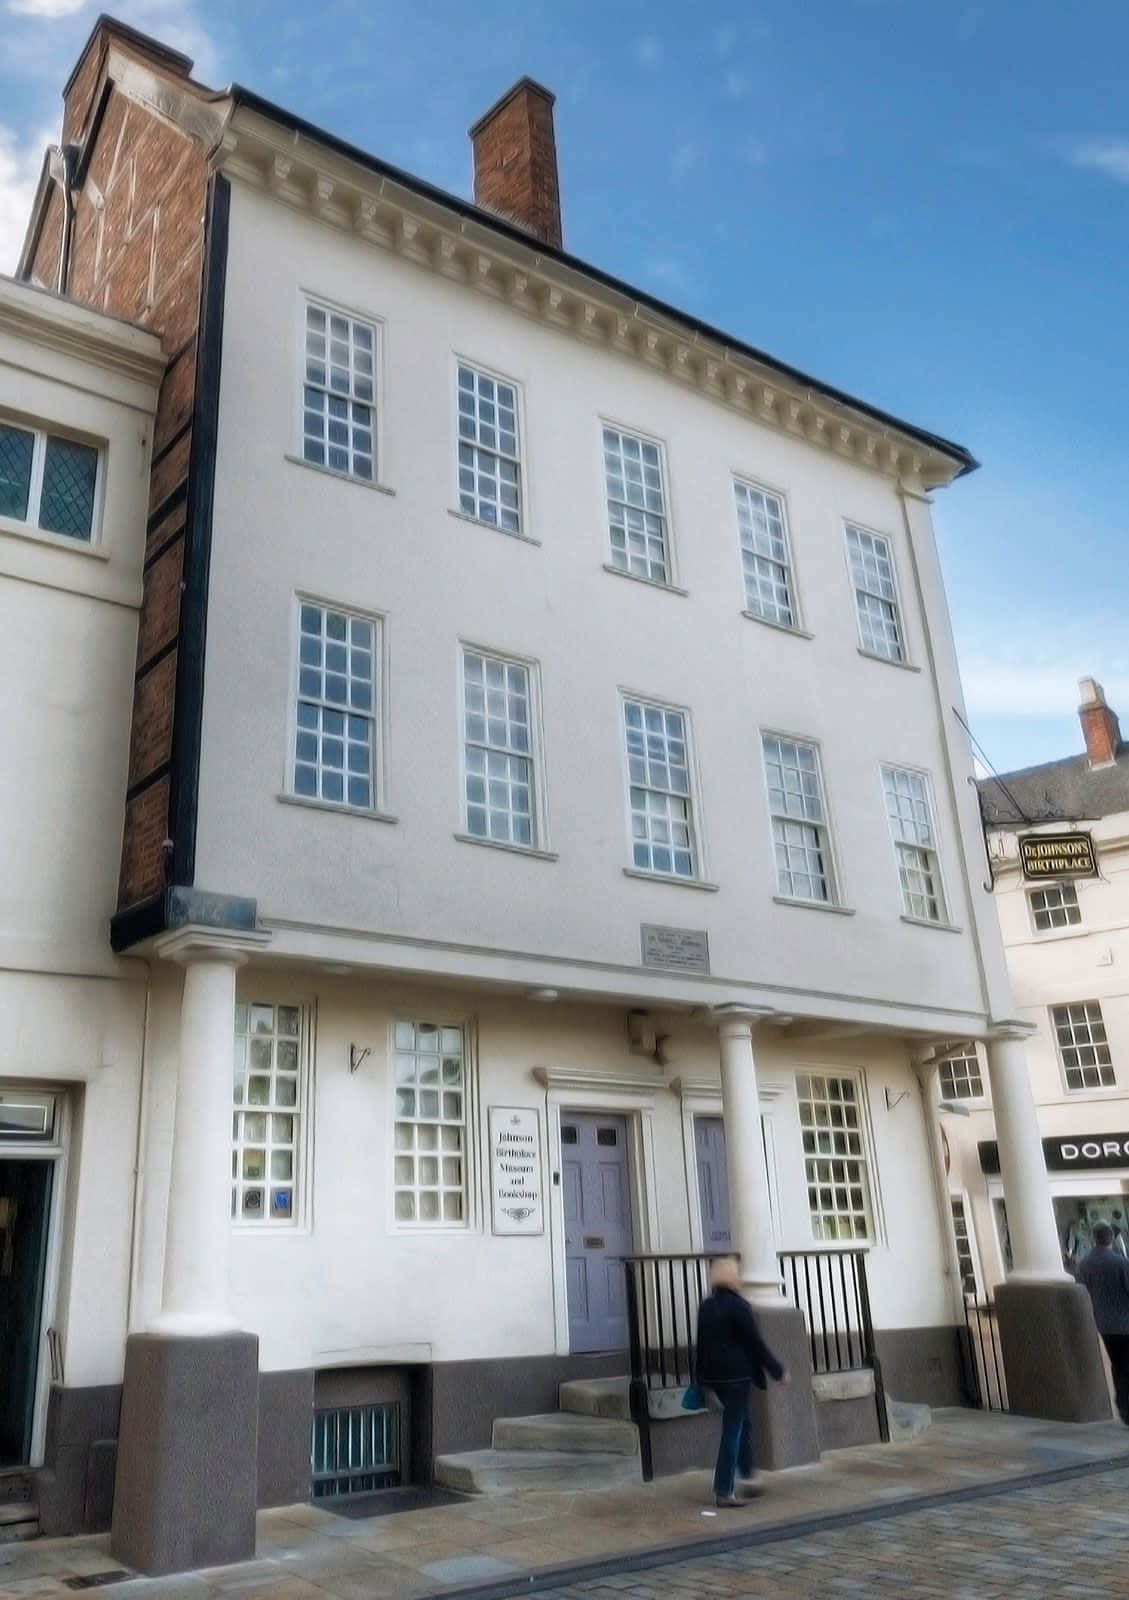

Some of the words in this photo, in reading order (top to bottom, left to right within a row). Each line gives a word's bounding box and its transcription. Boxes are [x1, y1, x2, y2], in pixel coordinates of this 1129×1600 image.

[1028, 857, 1089, 871] BIRTHPLACE
[499, 1131, 533, 1144] Johnson
[496, 1148, 536, 1160] Birthplace
[1061, 1141, 1129, 1159] DOR
[500, 1162, 533, 1173] Museum
[511, 1176, 525, 1185] and
[498, 1188, 537, 1201] Bookshop
